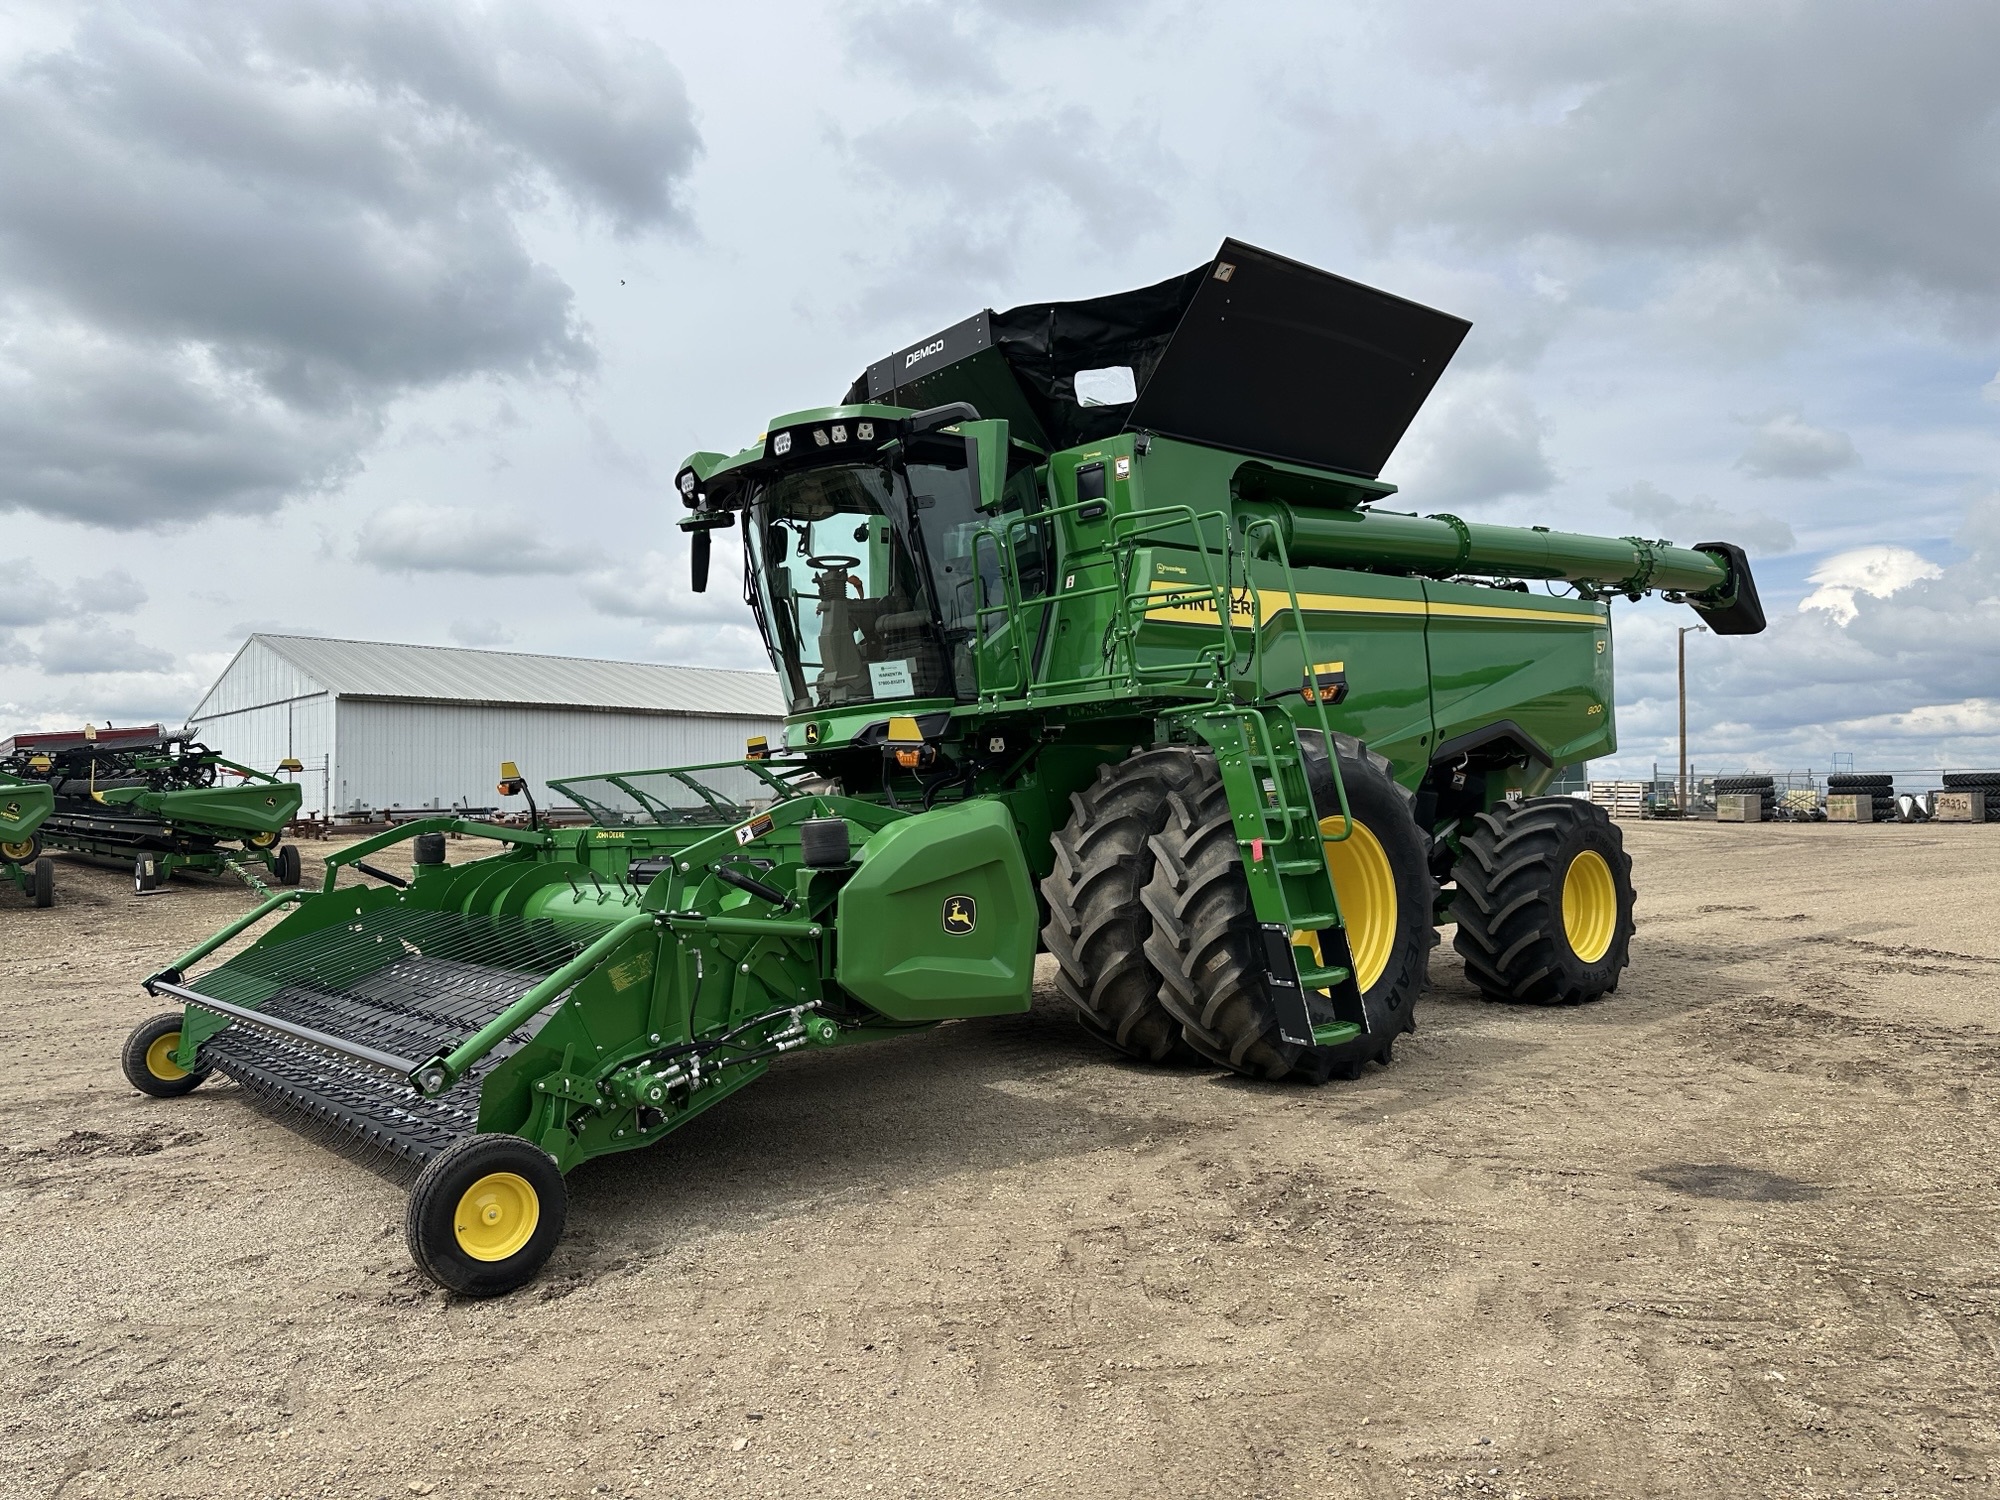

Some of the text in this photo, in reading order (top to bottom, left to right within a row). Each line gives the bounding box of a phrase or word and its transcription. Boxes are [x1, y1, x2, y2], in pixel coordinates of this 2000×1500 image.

[905, 339, 944, 369] DEMCO
[1596, 640, 1606, 654] S7
[1587, 704, 1602, 715] 800
[596, 831, 625, 839] JOHN DEERE
